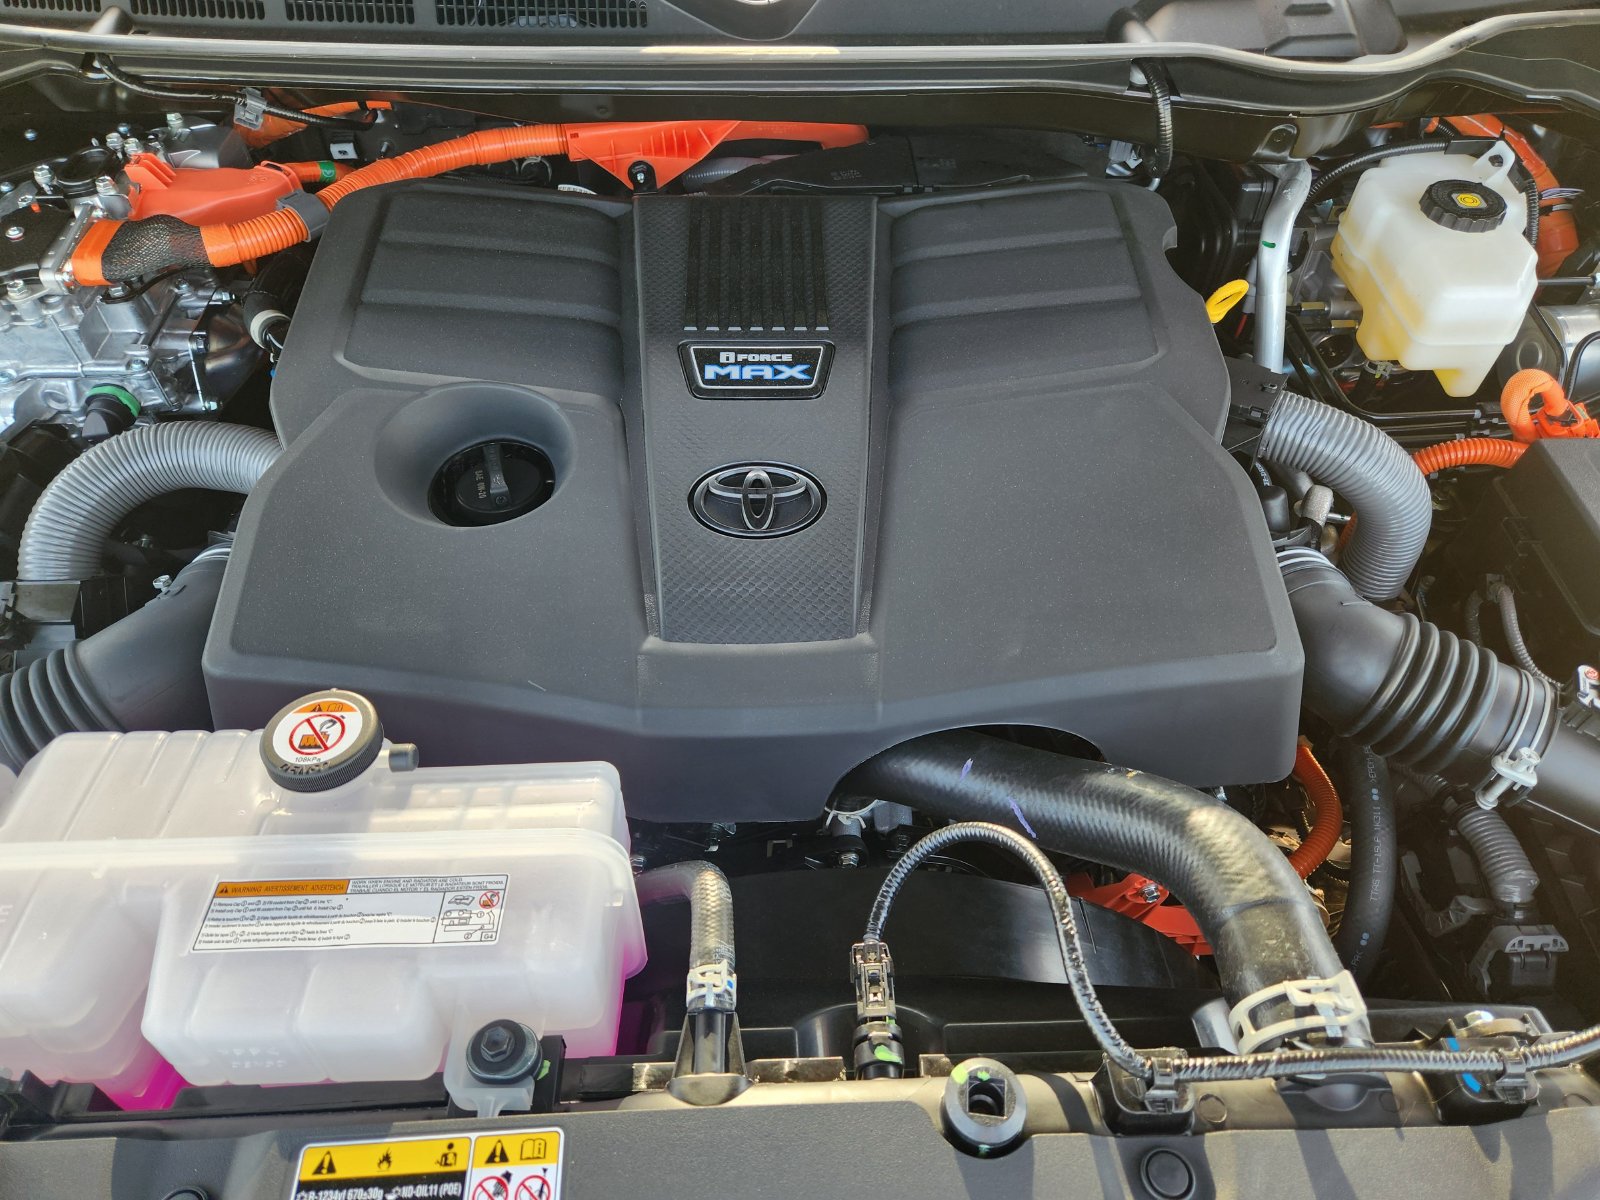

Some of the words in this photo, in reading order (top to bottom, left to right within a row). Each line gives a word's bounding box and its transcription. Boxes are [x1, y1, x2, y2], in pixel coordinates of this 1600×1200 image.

[737, 353, 793, 362] FORCE
[704, 364, 812, 380] MAX
[231, 885, 262, 893] WARNING
[264, 884, 309, 892] AVERTISSEMENT
[310, 883, 344, 891] ADVERTENCIA
[401, 1183, 438, 1199] ND-OIL11
[439, 1181, 462, 1198] (POE)
